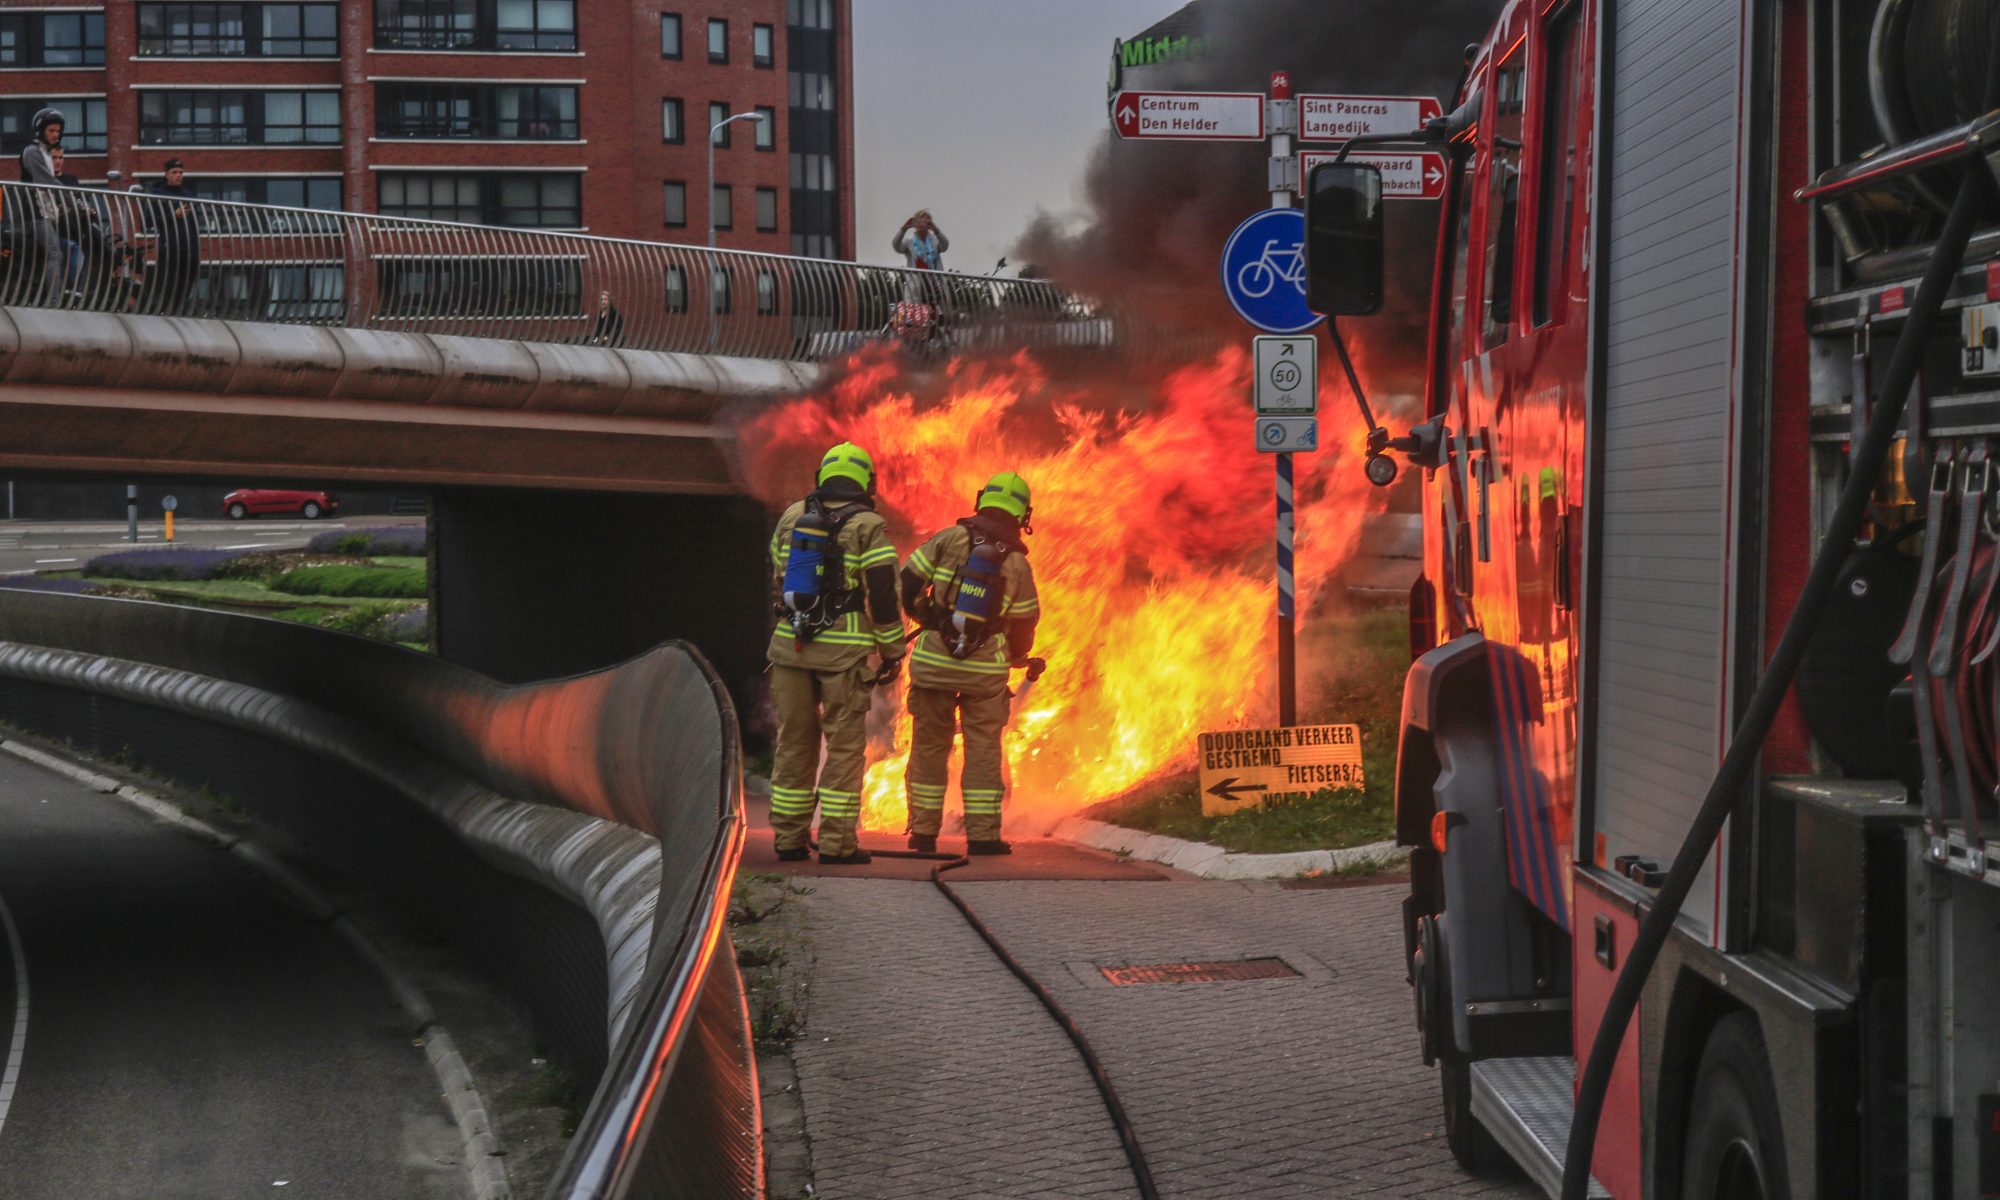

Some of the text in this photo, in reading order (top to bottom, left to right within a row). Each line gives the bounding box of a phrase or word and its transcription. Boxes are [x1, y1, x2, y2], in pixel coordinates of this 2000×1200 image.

[1141, 99, 1199, 111] Centrum
[1306, 101, 1388, 116] Sint Pancras
[1141, 118, 1218, 131] Den Helder
[1306, 121, 1370, 135] Langedijk
[1275, 369, 1295, 383] 50
[1205, 727, 1354, 751] DOORGAAND VERKEER
[1206, 748, 1281, 769] GESTREMD
